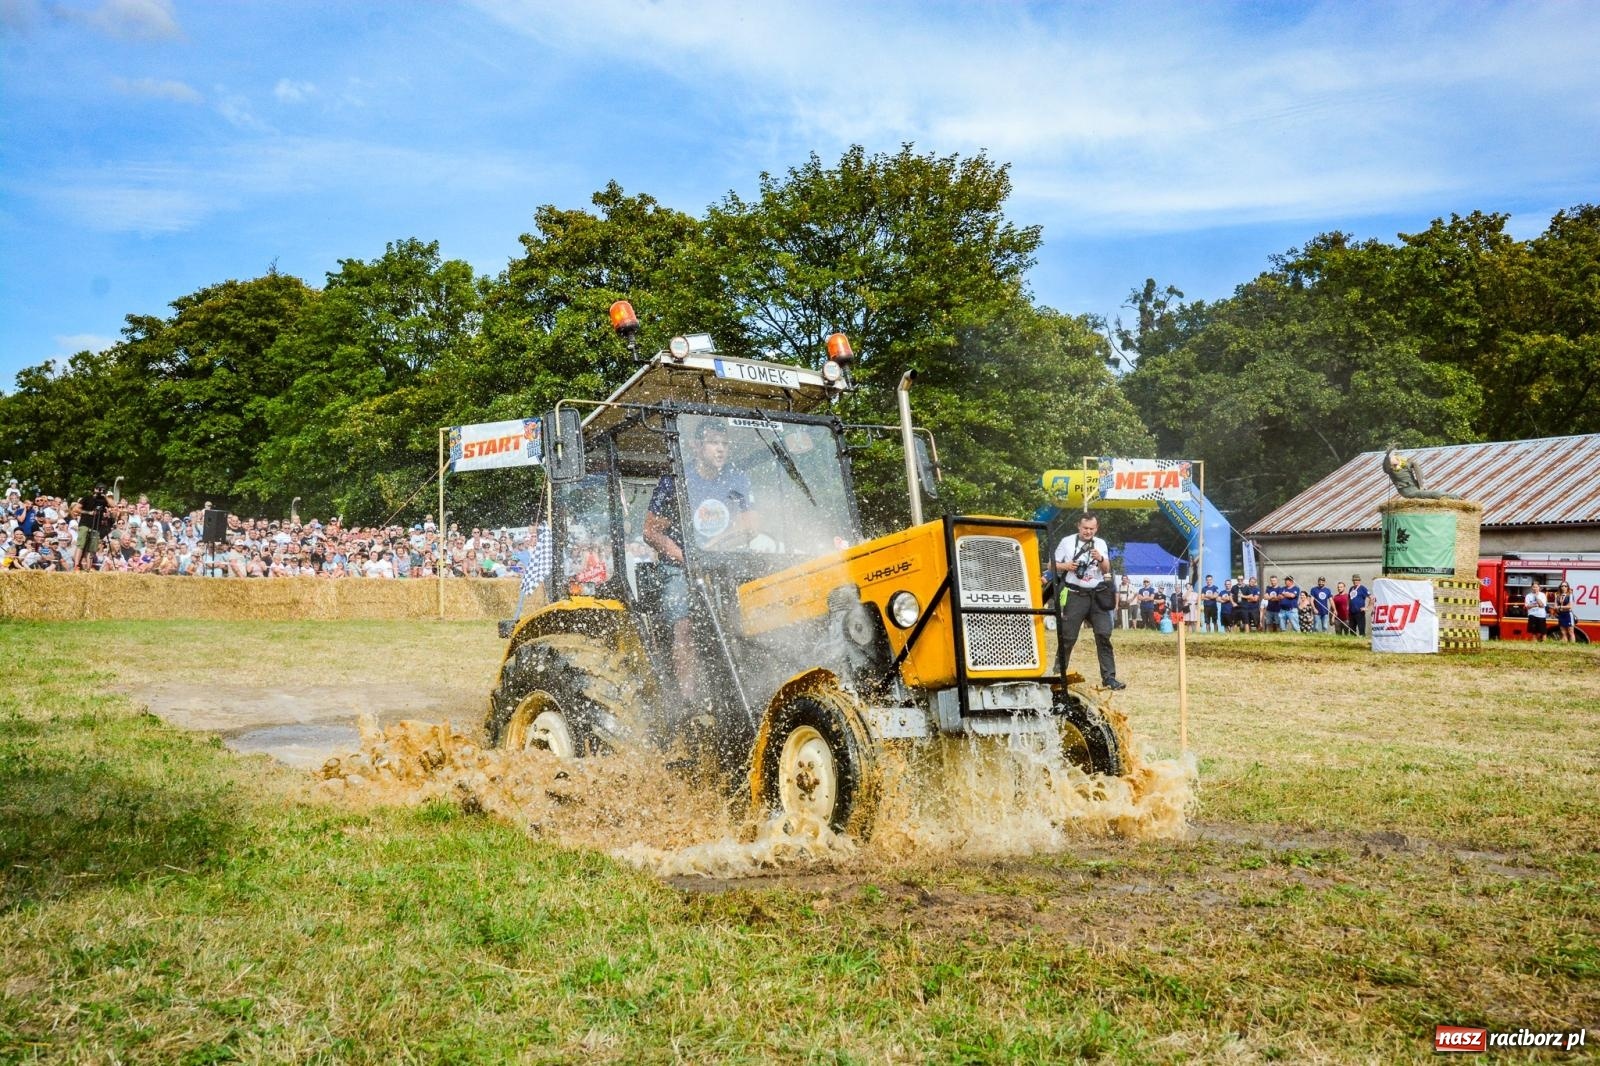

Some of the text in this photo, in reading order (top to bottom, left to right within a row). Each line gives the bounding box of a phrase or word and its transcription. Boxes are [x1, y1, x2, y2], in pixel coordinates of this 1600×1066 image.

[736, 363, 788, 384] TOMEK
[463, 434, 523, 459] START
[1114, 470, 1180, 490] META
[864, 561, 912, 582] URSUS
[967, 593, 1025, 604] URSUS
